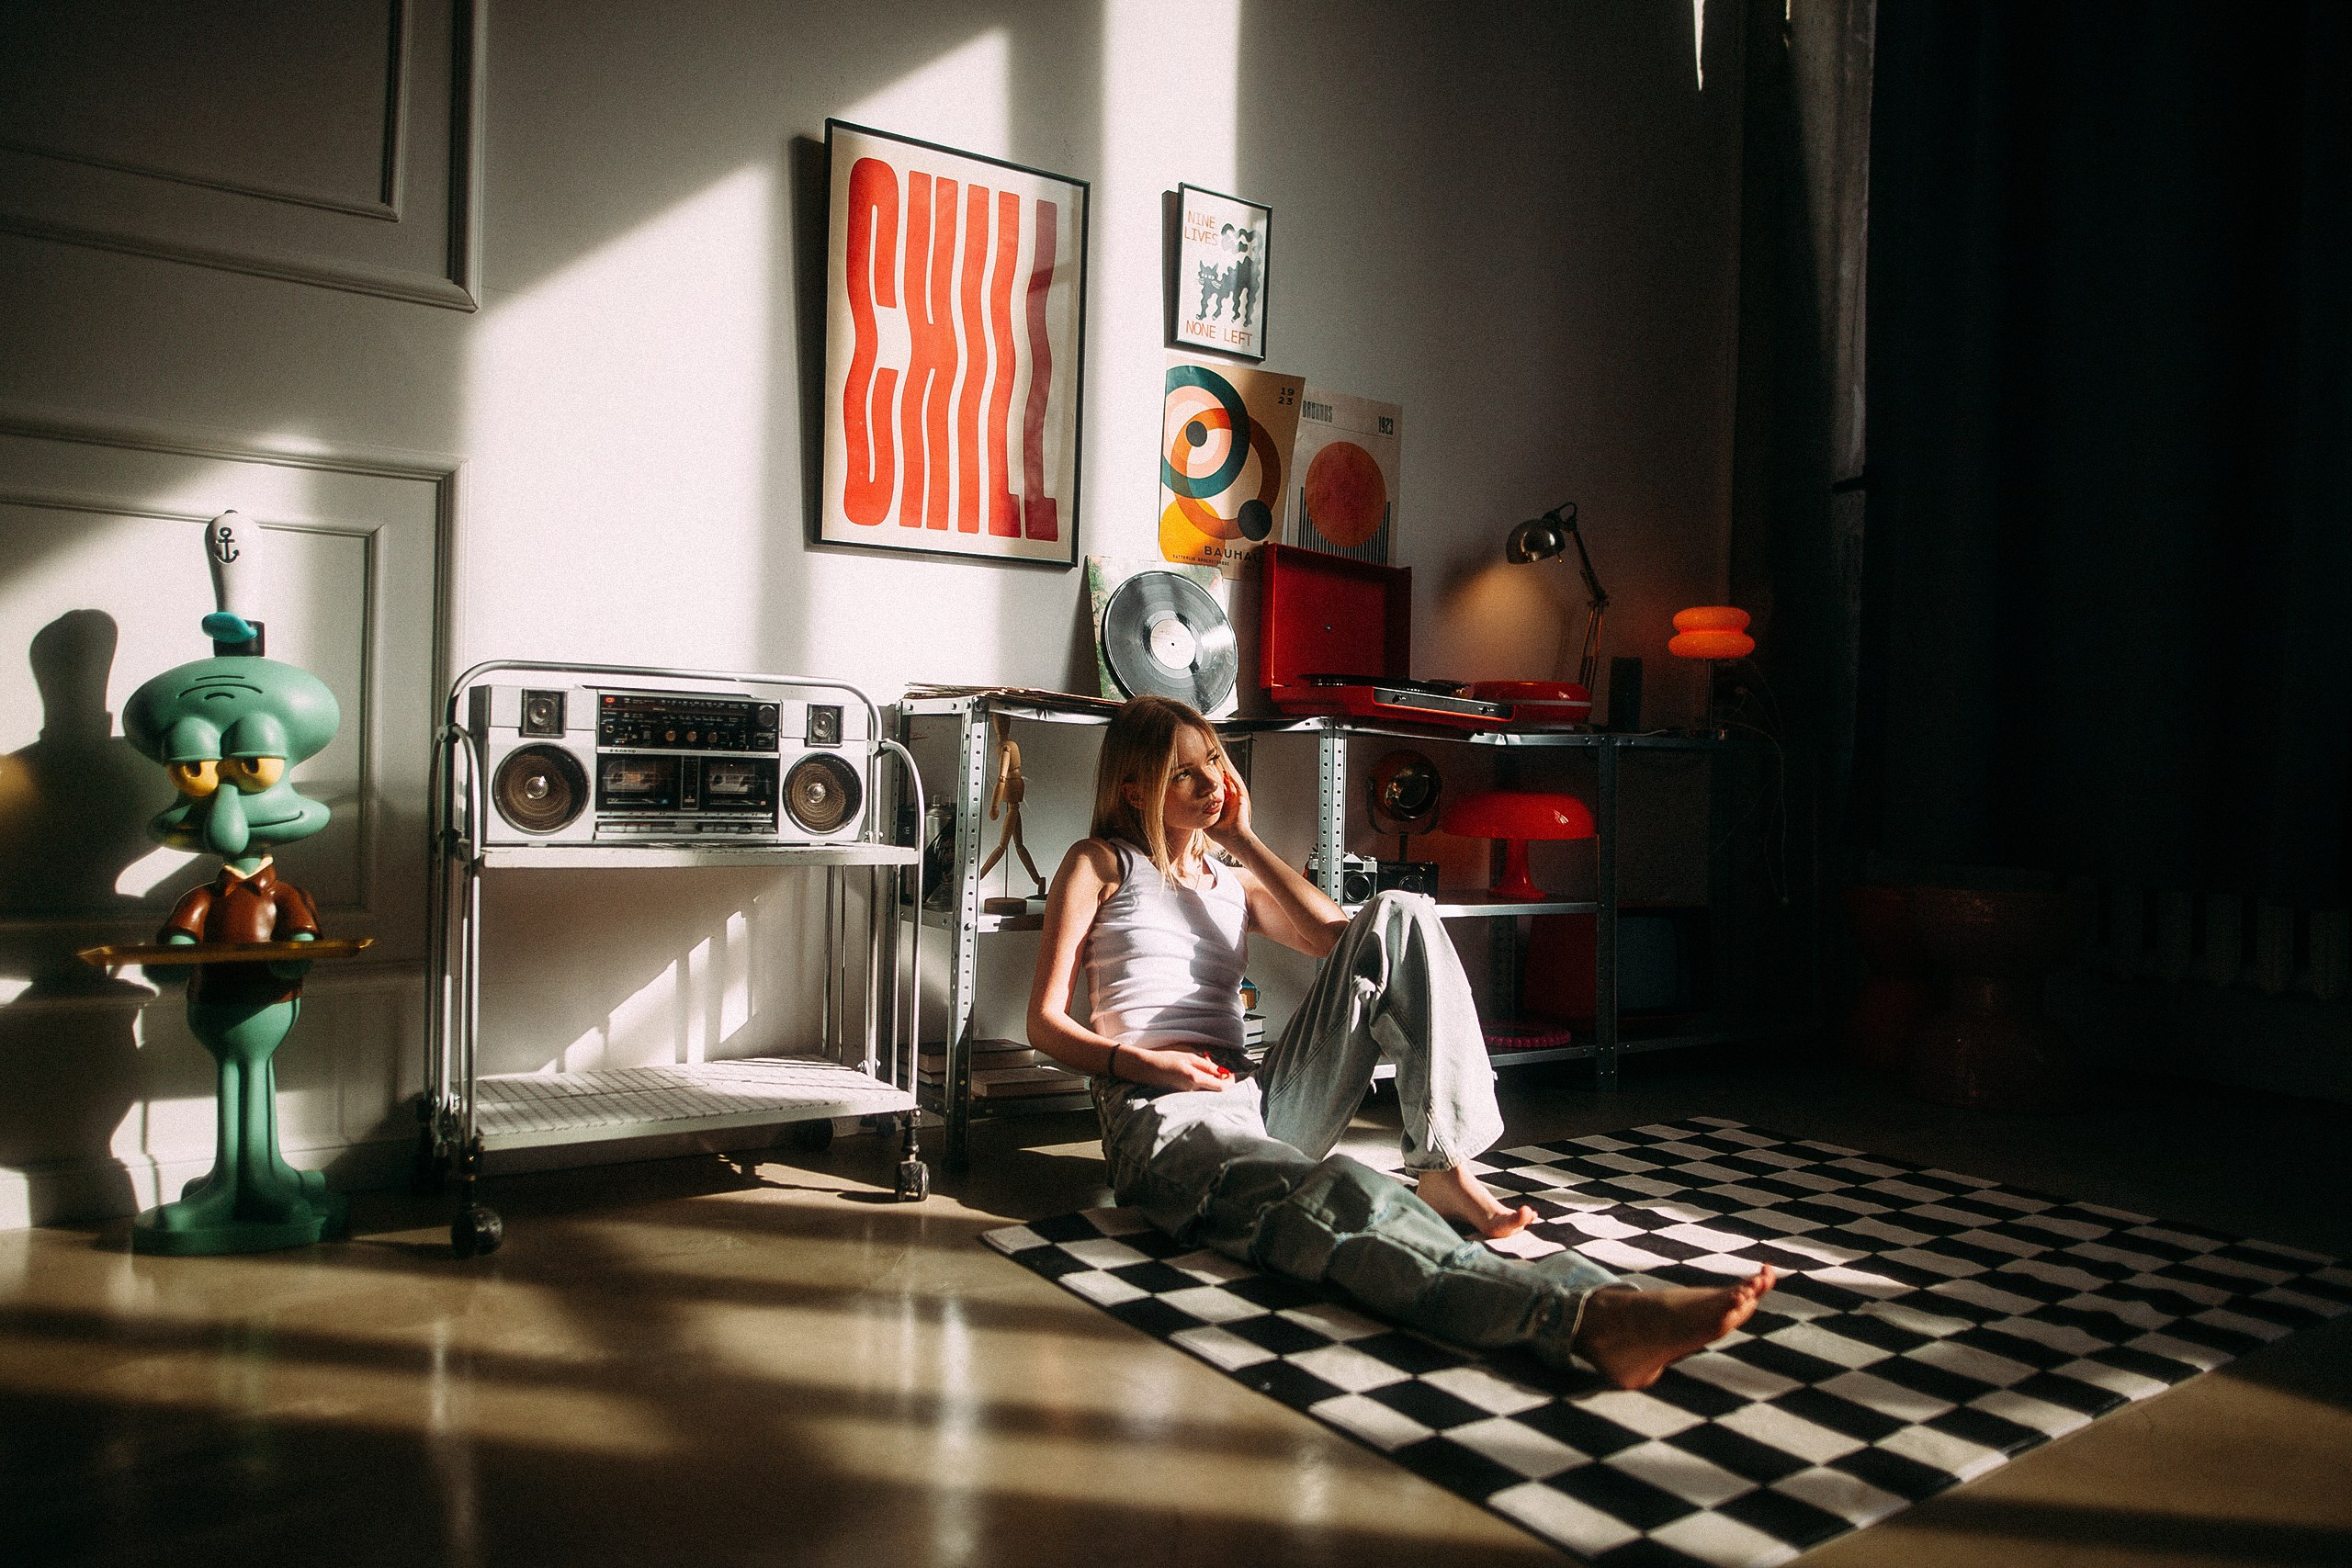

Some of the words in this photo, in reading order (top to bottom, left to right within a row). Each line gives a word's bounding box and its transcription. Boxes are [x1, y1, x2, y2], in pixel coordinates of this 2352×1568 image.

[1187, 209, 1216, 230] NINE
[1184, 226, 1219, 246] LIVES
[1185, 320, 1216, 339] NONE
[1224, 329, 1253, 347] LEFT
[842, 156, 1060, 543] CHILL
[1277, 396, 1294, 406] 23
[1280, 387, 1295, 397] 19
[1302, 400, 1333, 423] BAUHAUS
[1378, 415, 1394, 435] 1923
